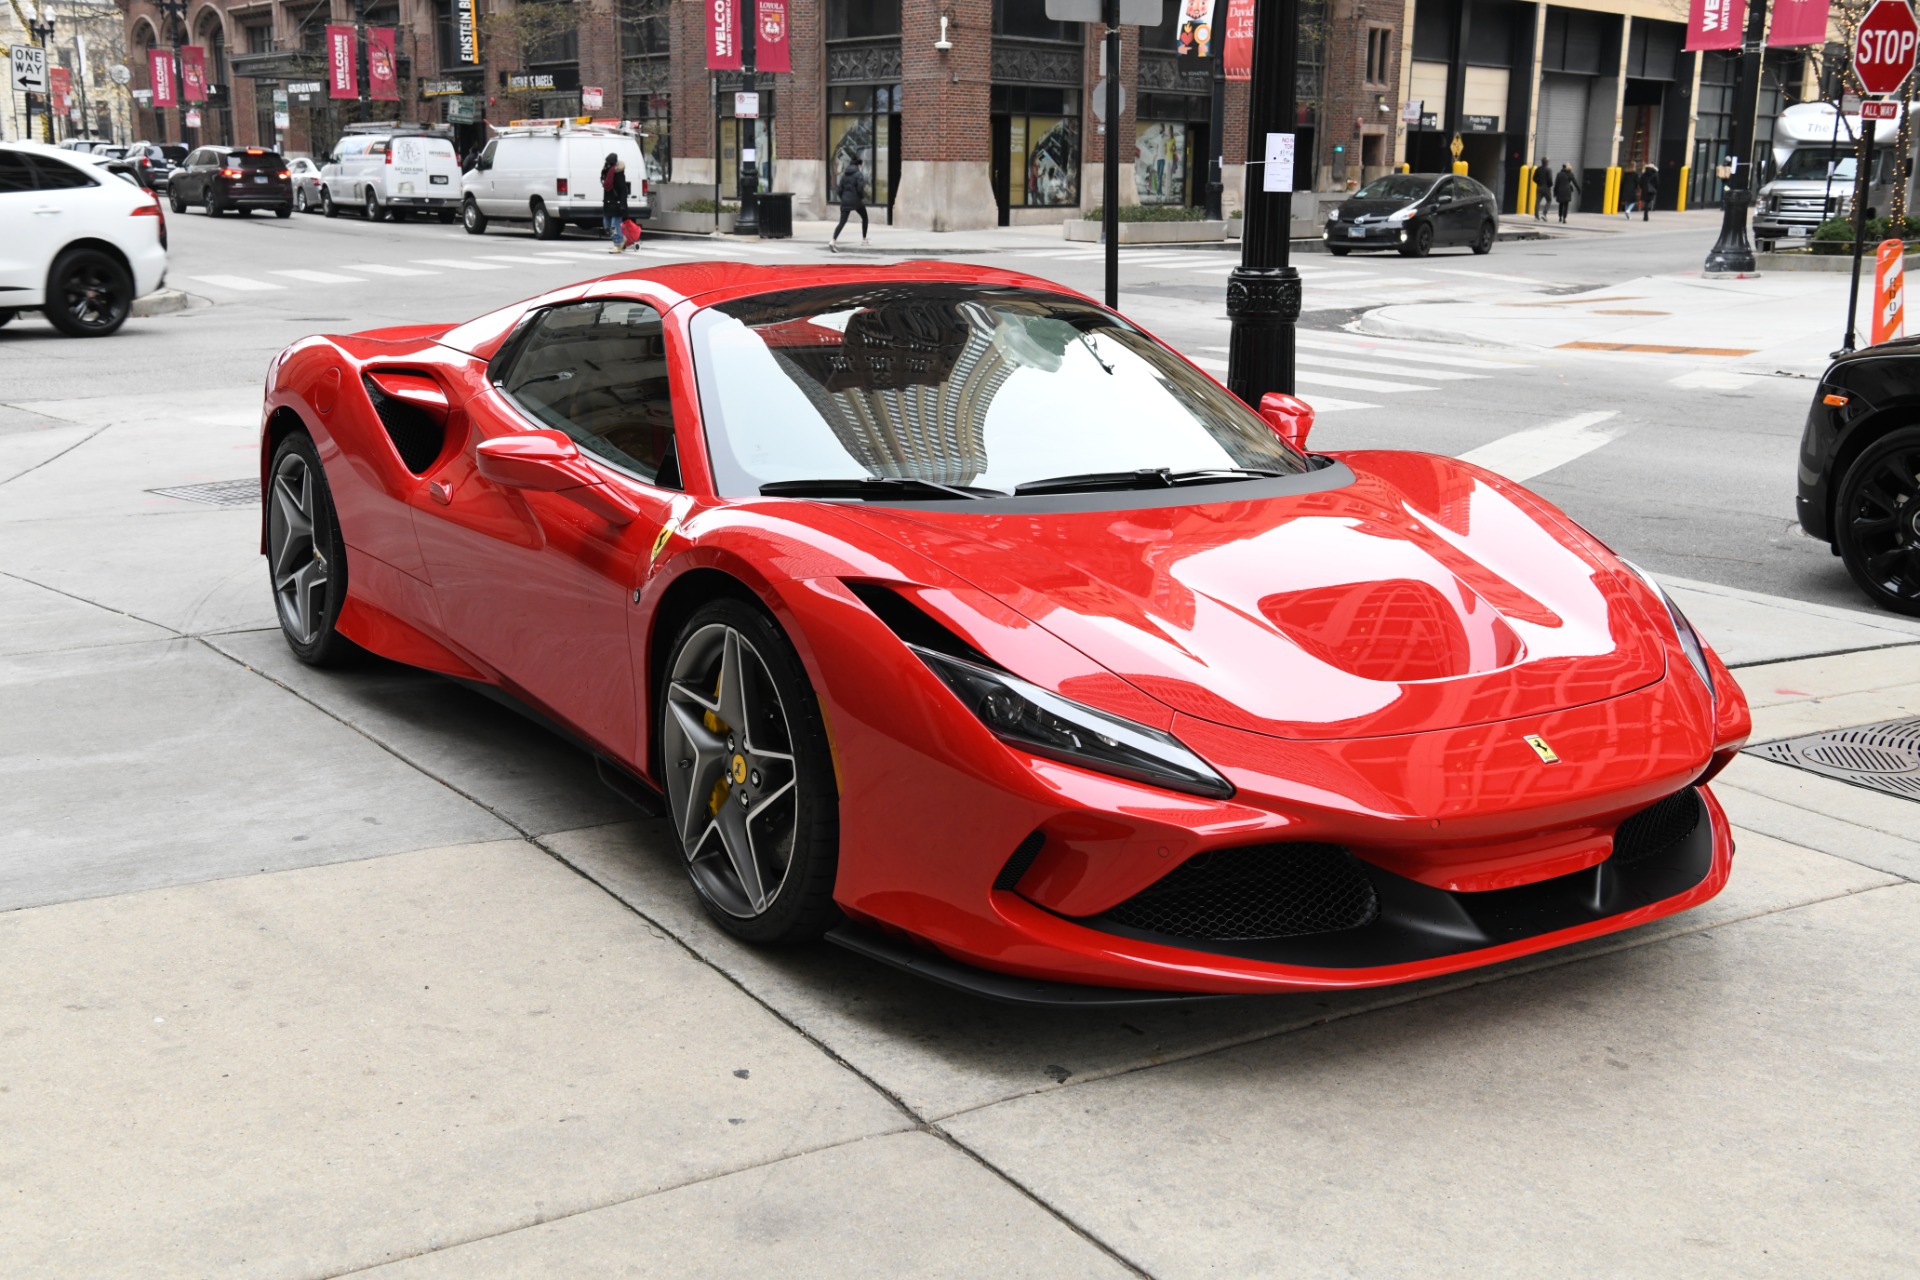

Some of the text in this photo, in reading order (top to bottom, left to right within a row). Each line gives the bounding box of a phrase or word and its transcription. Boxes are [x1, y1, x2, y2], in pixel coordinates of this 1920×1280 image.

[1229, 6, 1254, 17] David
[714, 0, 726, 56] WELCO
[1239, 17, 1253, 27] Lee
[459, 12, 473, 62] EINSTEIN
[1858, 29, 1914, 65] STOP
[15, 49, 41, 63] ONE
[334, 34, 346, 90] WELCOME
[15, 62, 42, 75] WAY
[155, 57, 165, 100] WELCOME
[535, 75, 553, 87] BAGELS
[1864, 105, 1895, 116] ALL WAY
[1808, 123, 1830, 132] The
